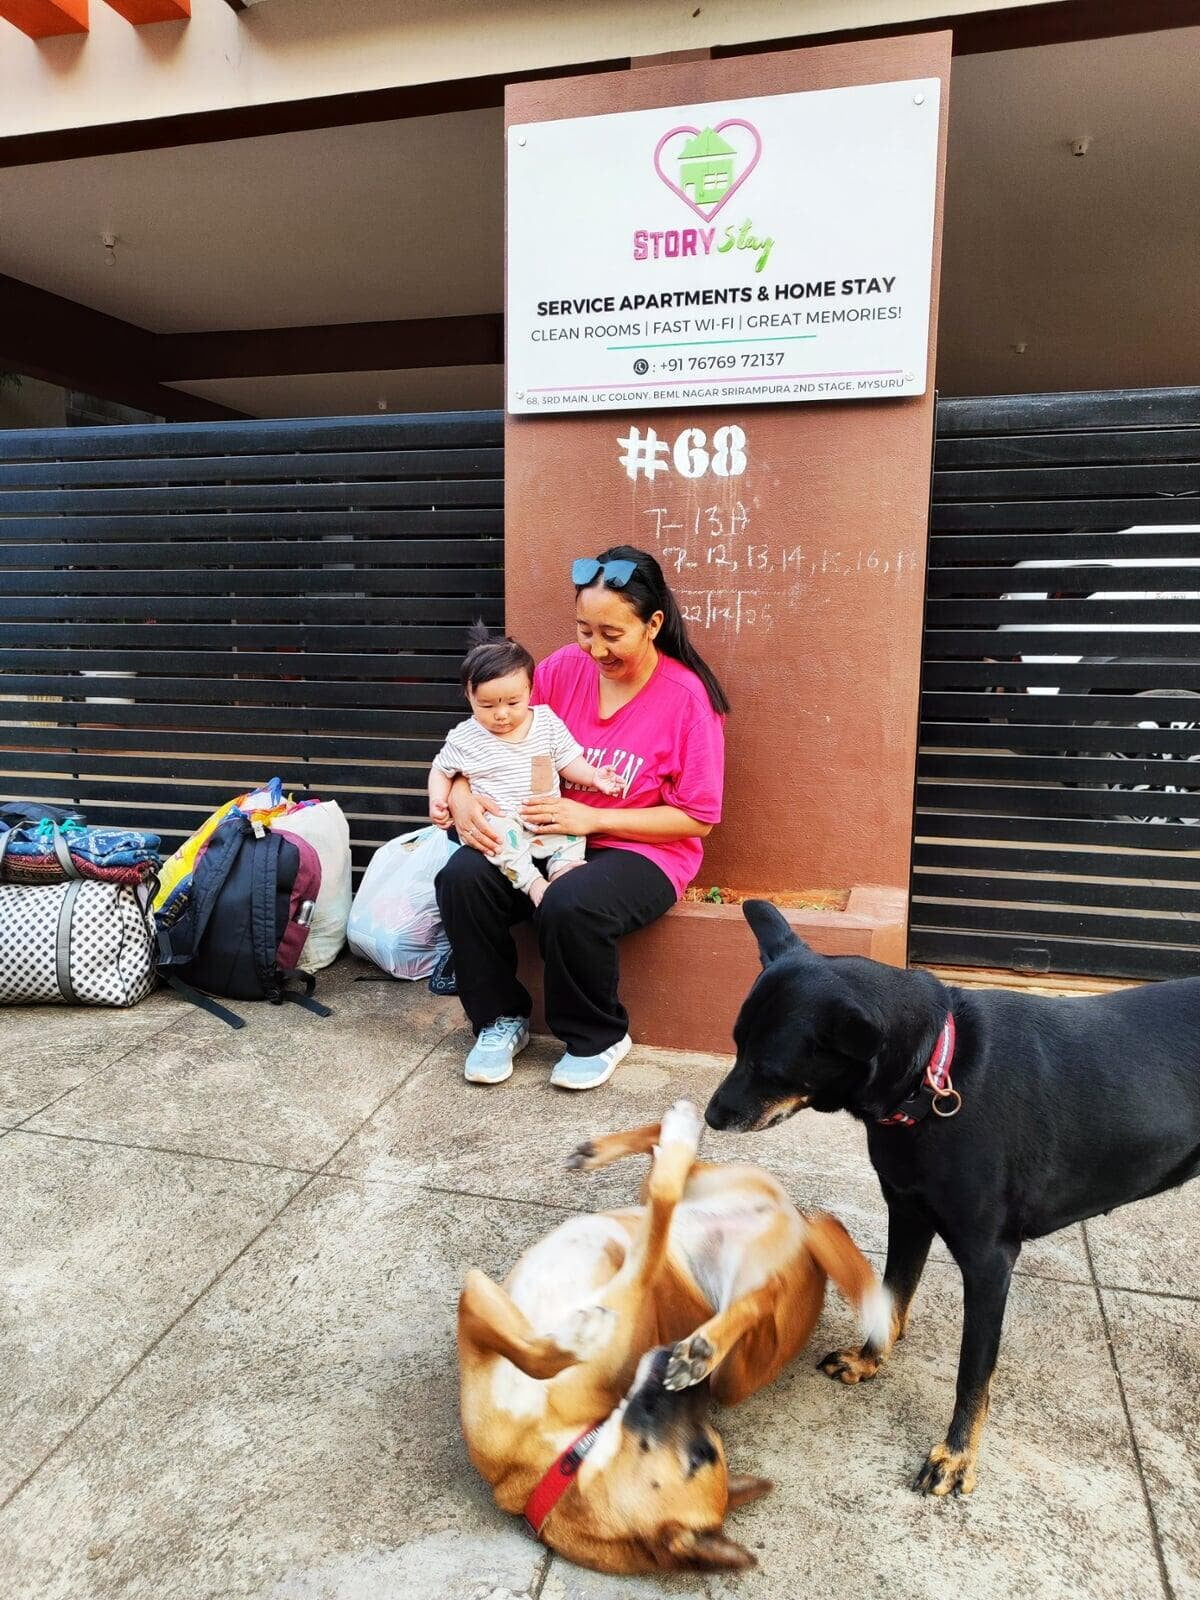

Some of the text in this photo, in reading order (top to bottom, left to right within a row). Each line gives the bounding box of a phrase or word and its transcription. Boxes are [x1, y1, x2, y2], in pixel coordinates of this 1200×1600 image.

[633, 218, 775, 273] STORY Stay
[537, 276, 896, 317] SERVICE APARTMENTS & HOME STAY
[531, 327, 580, 342] CLEAN
[584, 323, 641, 339] ROOMS
[653, 319, 691, 335] FAST
[694, 317, 734, 332] WI-FI
[747, 312, 801, 328] GREAT
[806, 306, 902, 325] MEMORIES!
[660, 358, 683, 372] +91
[688, 355, 736, 370] 76769
[741, 352, 785, 368] 72137
[541, 396, 561, 405] 3RD
[592, 393, 606, 403] LIC
[653, 390, 680, 400] BEML
[683, 388, 719, 398] NAGAR
[721, 384, 791, 396] SRIRAMPURA
[793, 383, 816, 393] 2ND
[857, 378, 904, 389] MYSURU
[616, 424, 748, 481] #68
